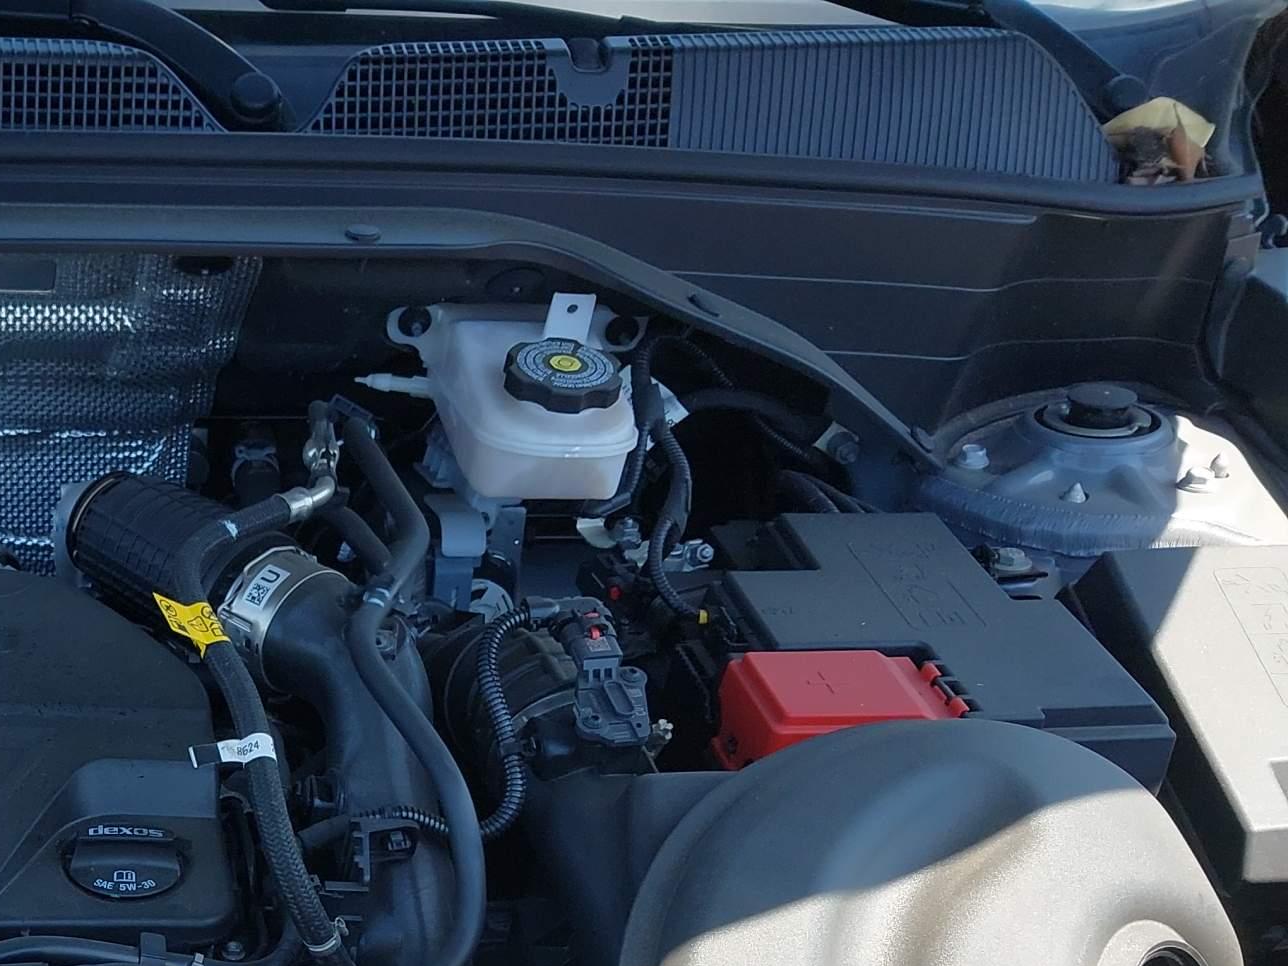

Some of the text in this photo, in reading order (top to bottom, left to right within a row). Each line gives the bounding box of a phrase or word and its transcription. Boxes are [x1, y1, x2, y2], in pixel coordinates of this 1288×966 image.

[261, 569, 281, 583] U
[88, 825, 165, 837] dexos
[93, 879, 156, 891] SAE 5W-30
